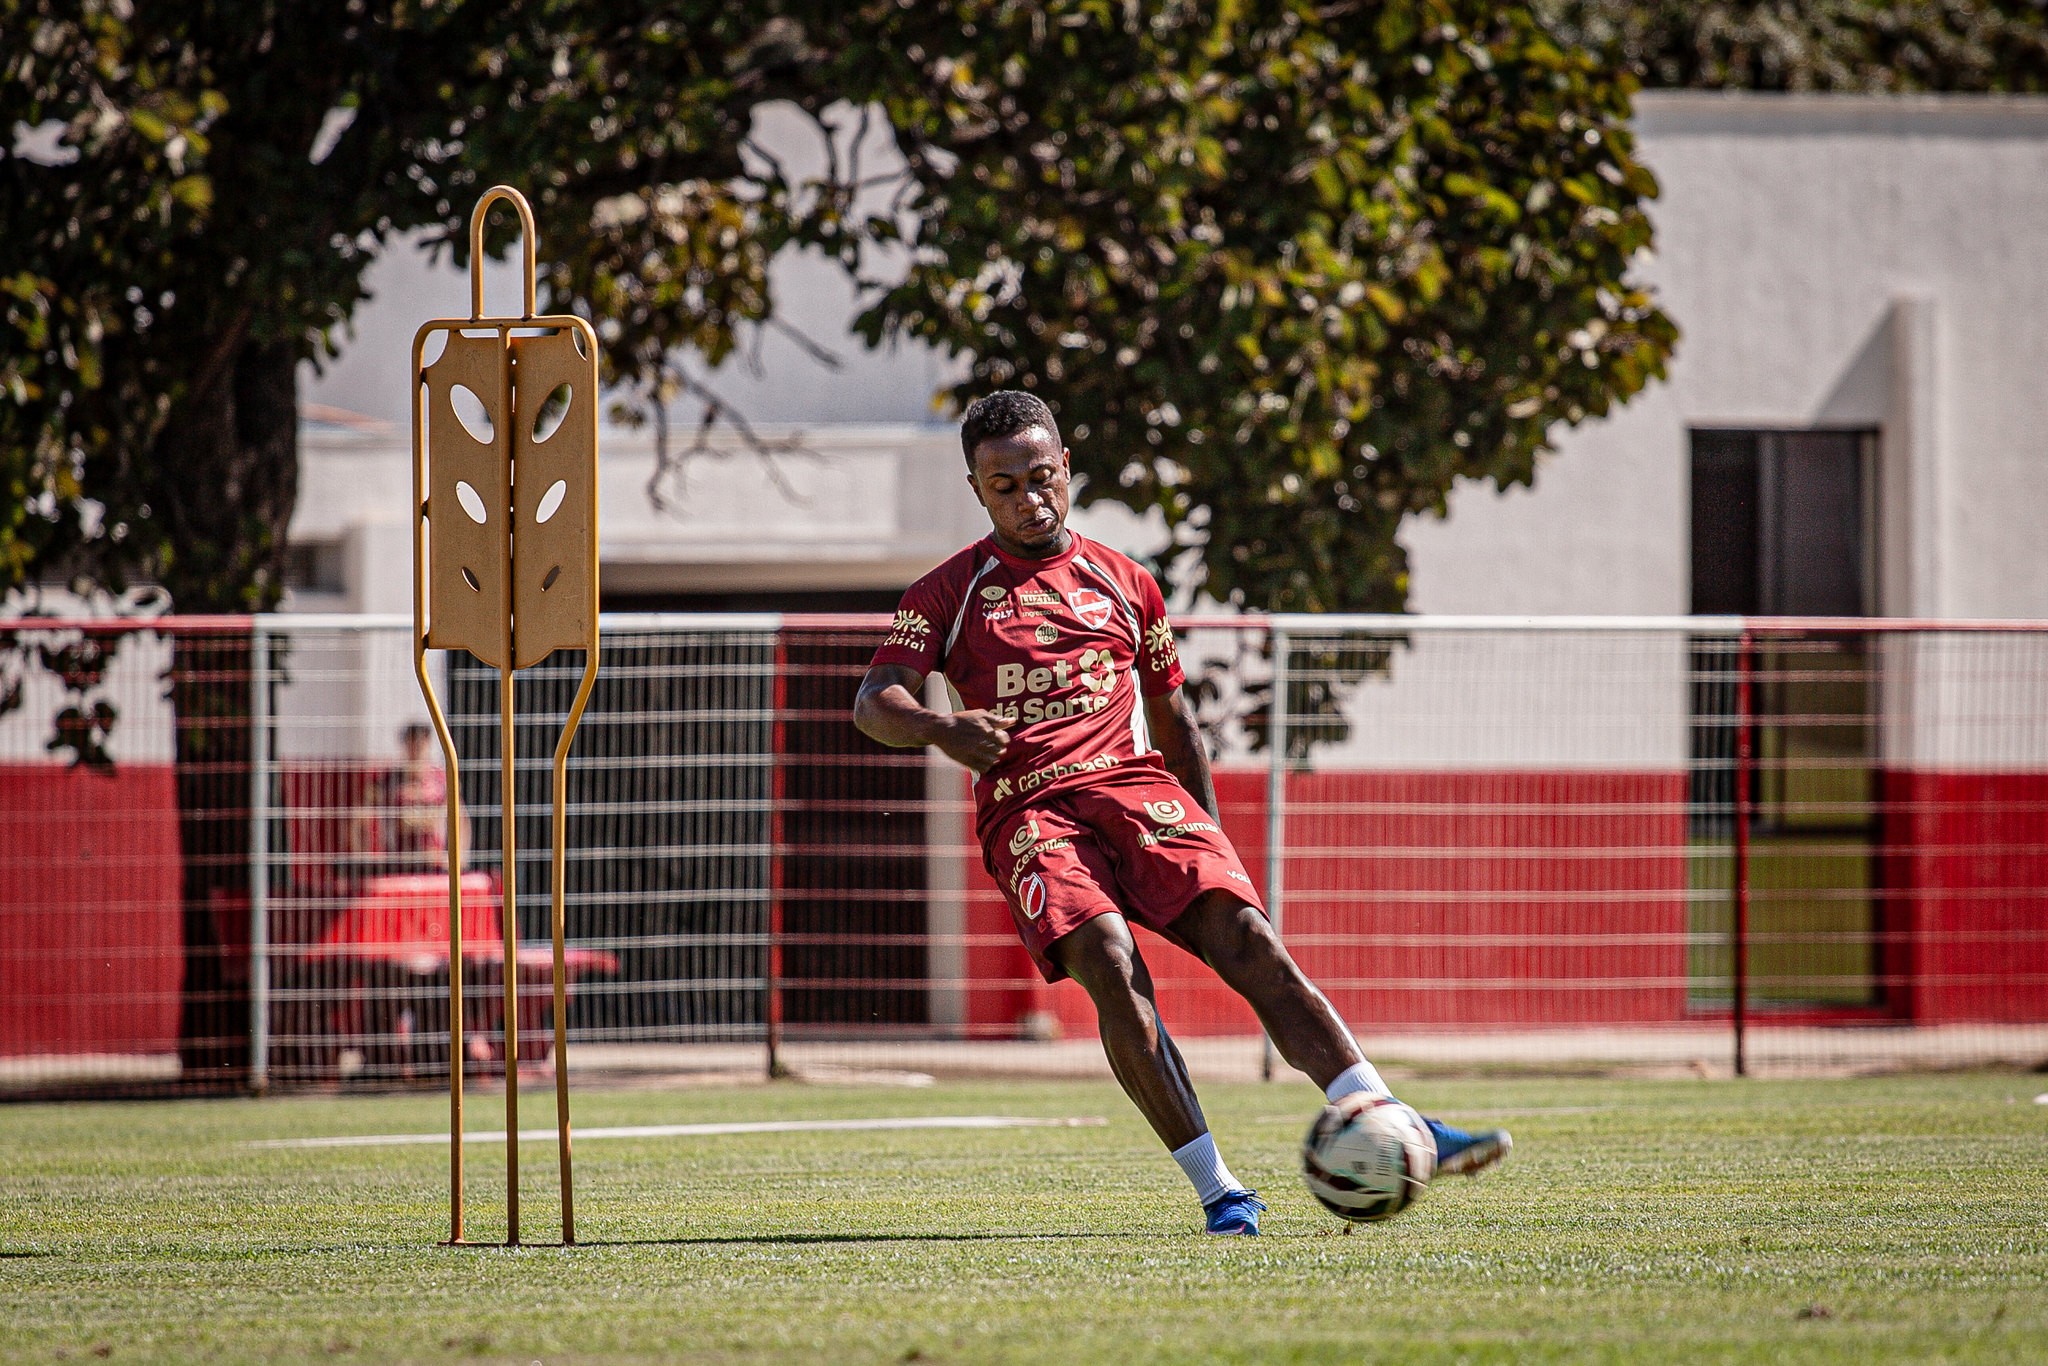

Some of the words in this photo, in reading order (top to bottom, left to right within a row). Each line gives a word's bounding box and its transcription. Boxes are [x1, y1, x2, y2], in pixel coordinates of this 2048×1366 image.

[997, 659, 1073, 698] Bet
[1022, 693, 1109, 724] Sorte
[1009, 837, 1070, 894] UniCesumar
